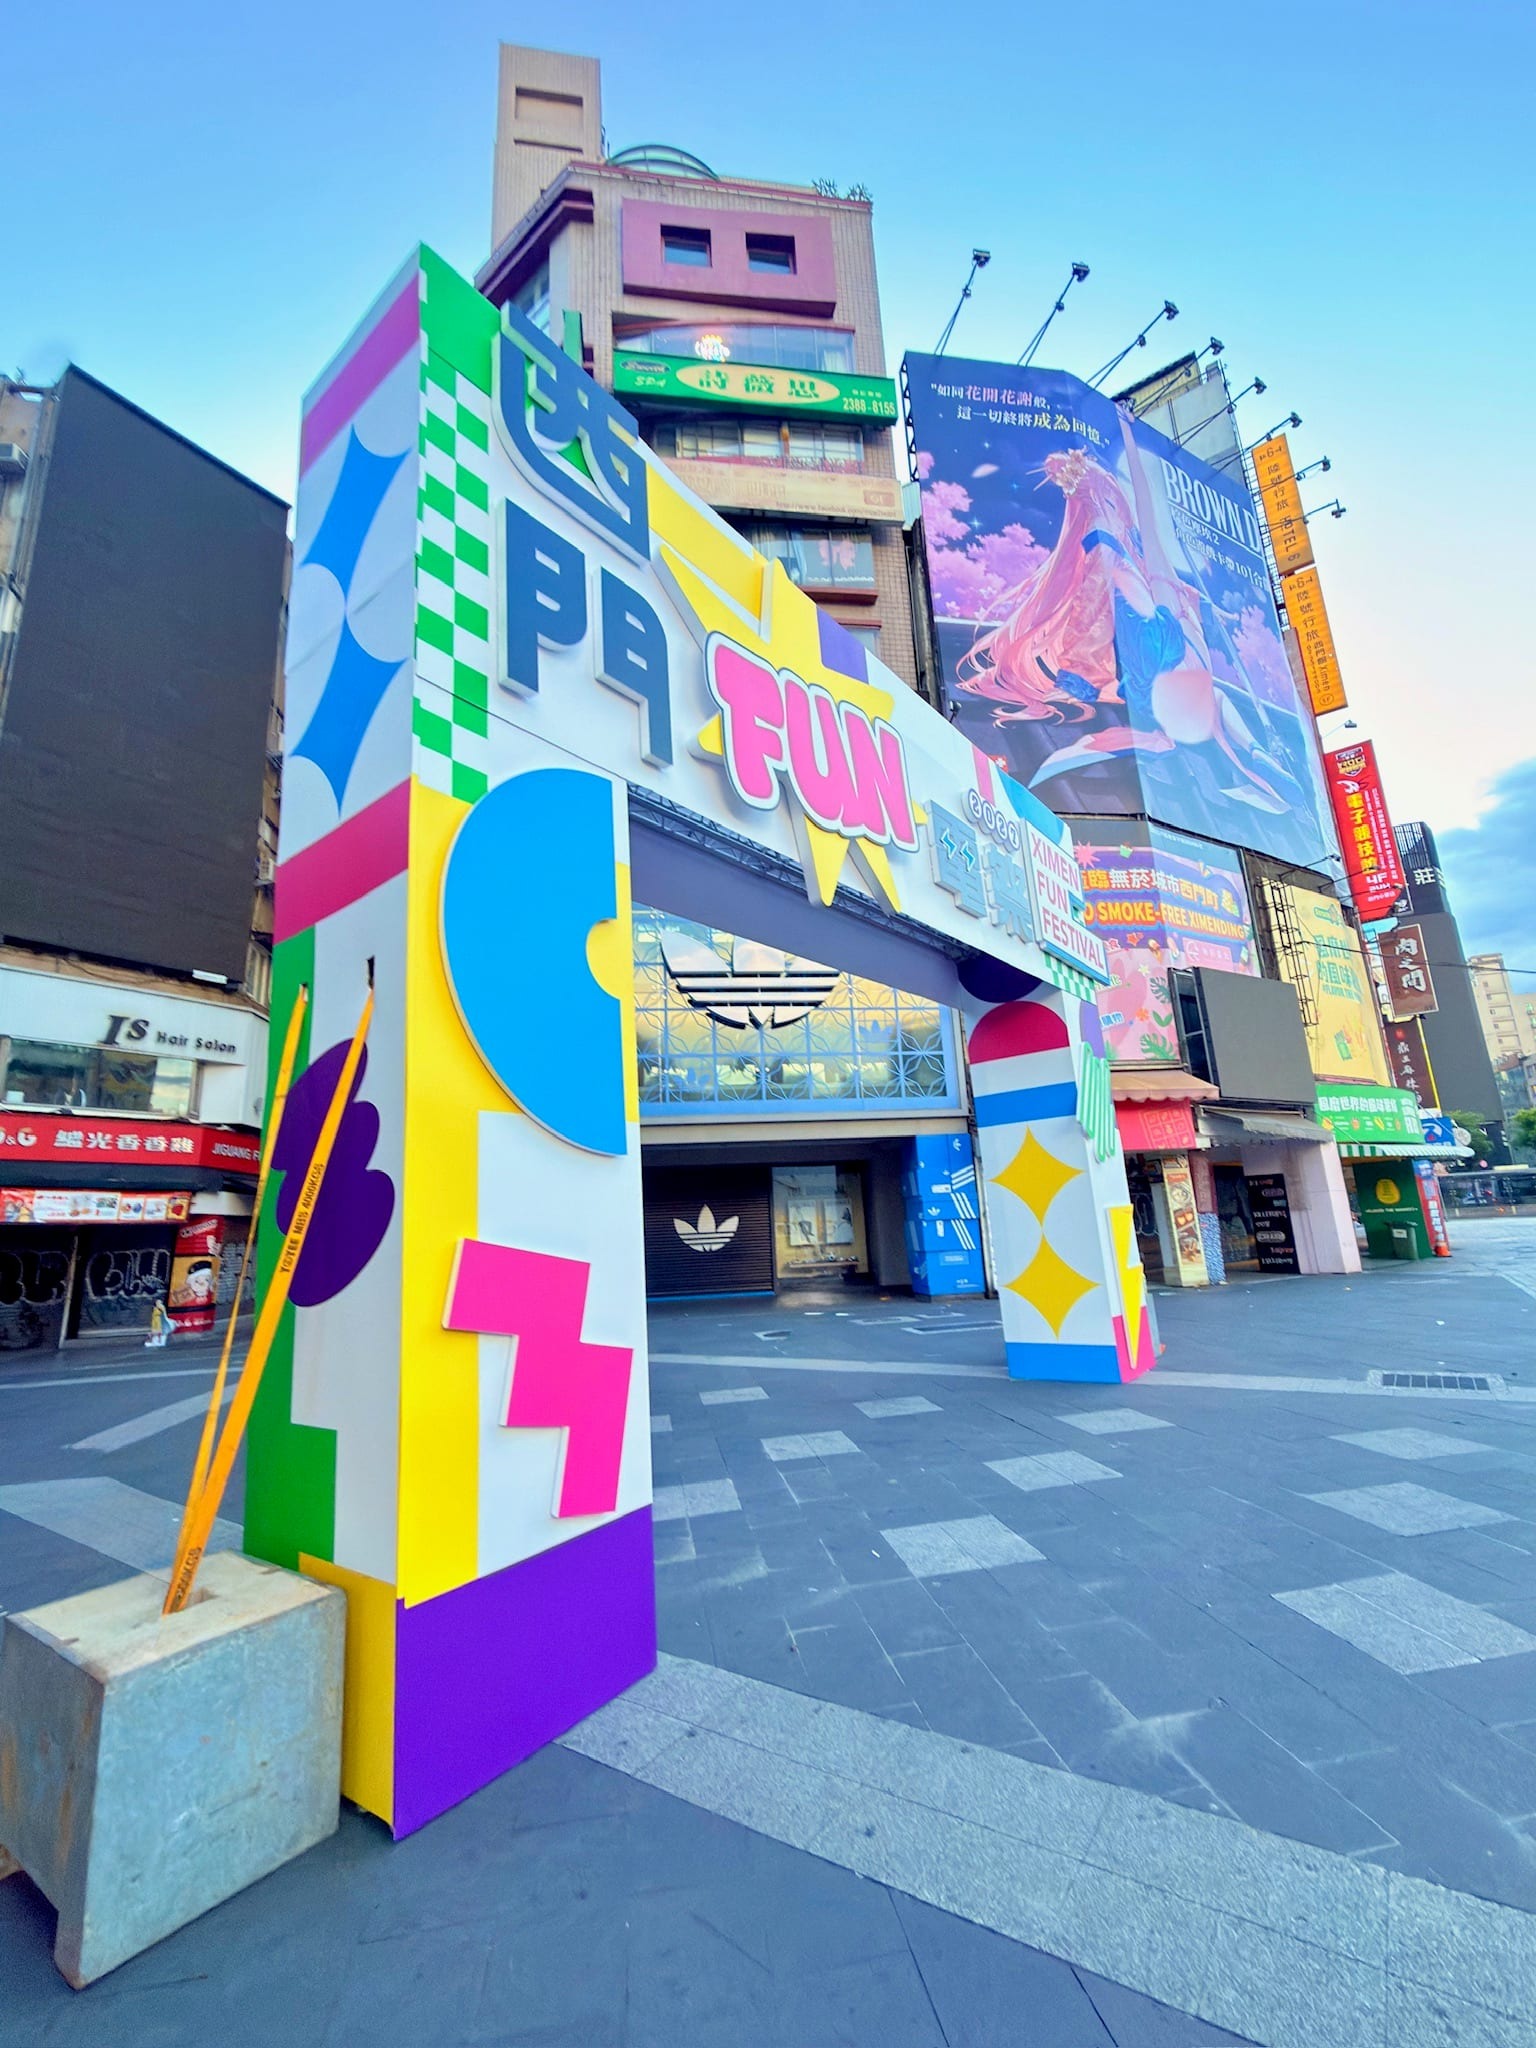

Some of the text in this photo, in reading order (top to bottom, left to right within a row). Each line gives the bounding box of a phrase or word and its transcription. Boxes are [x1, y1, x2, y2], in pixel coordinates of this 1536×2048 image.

[1160, 456, 1245, 544] BROWN
[1280, 516, 1297, 553] HOTEL
[708, 636, 918, 850] FUN
[1031, 832, 1079, 891] XIMEN
[1366, 872, 1388, 885] 4F
[1037, 870, 1069, 914] FUN
[1042, 907, 1105, 970] FESTIVAL
[1097, 901, 1187, 926] SMOKE-FREE
[1188, 911, 1245, 939] XIMENDING
[101, 1014, 236, 1054] IS Hair Salon
[212, 1142, 251, 1160] JIGUANG
